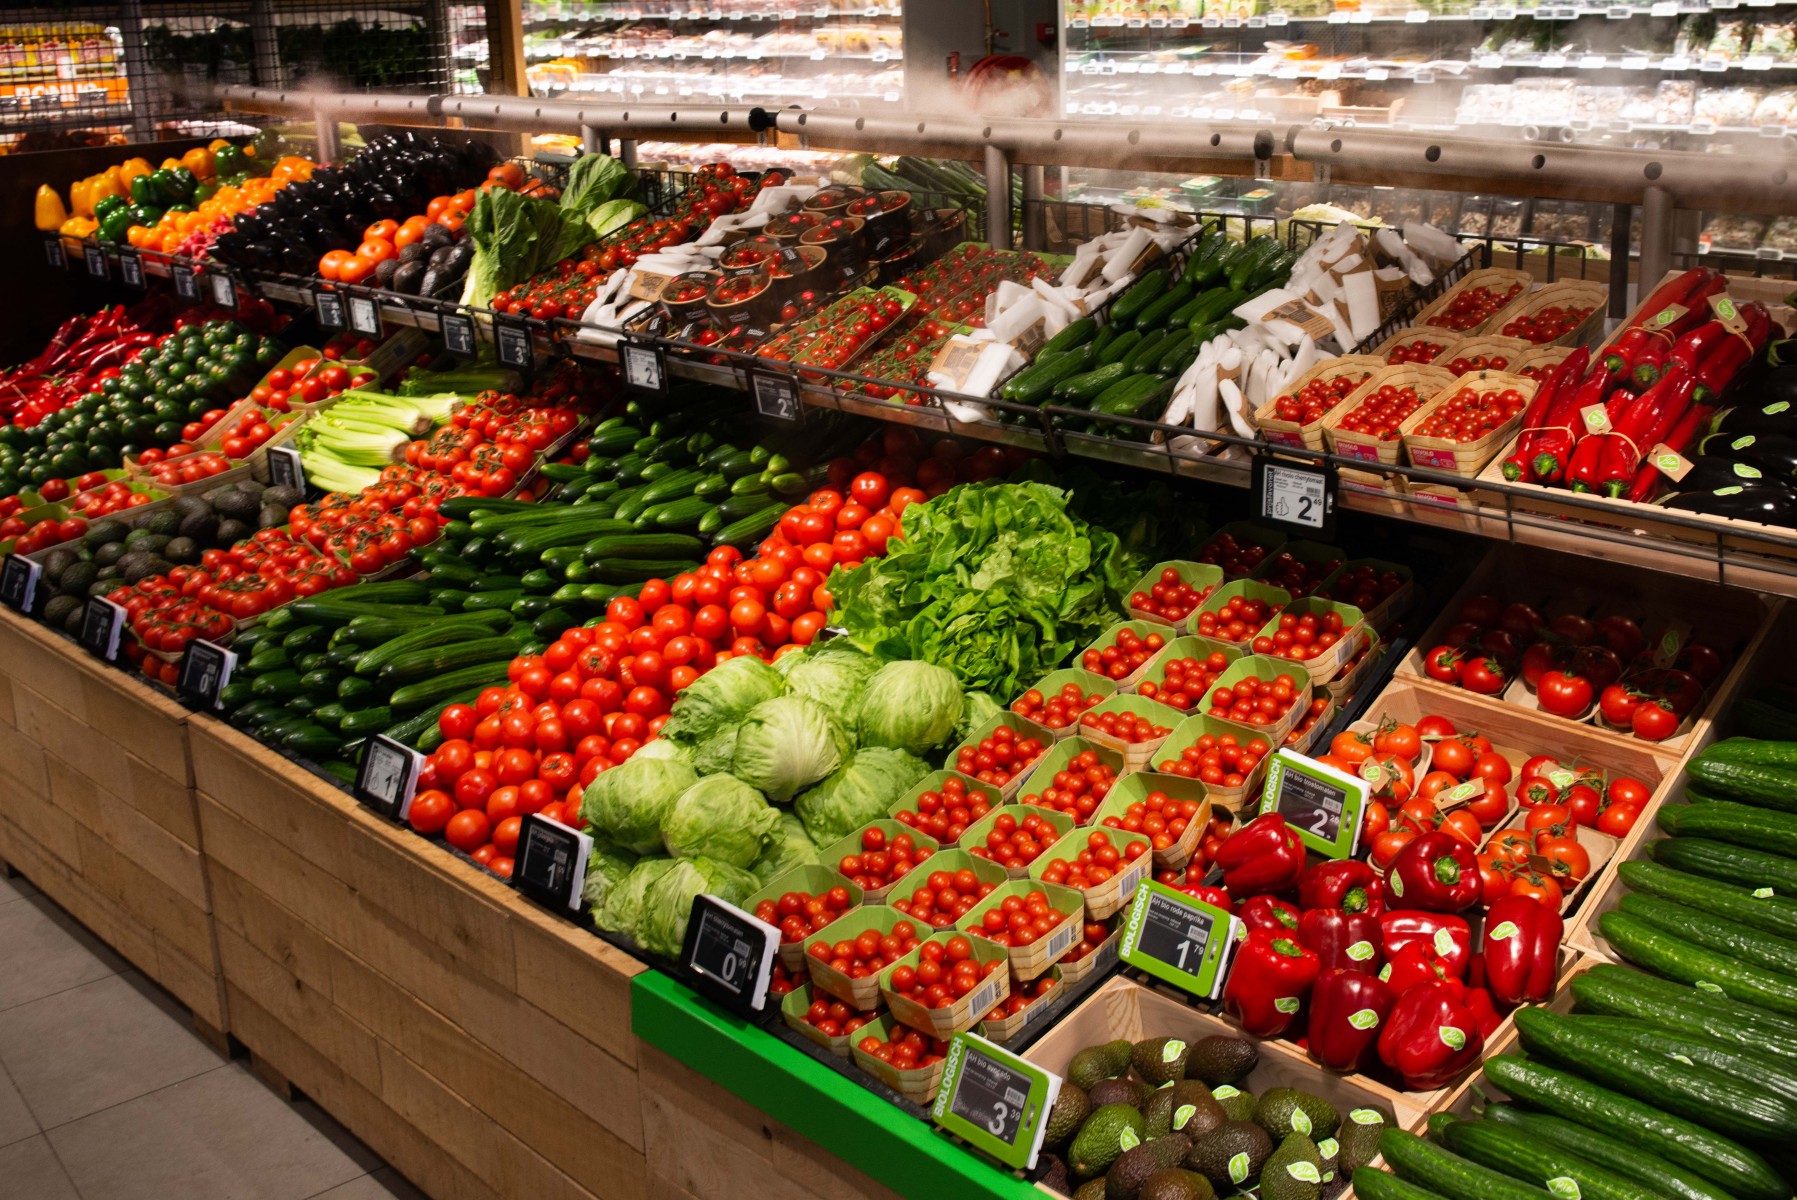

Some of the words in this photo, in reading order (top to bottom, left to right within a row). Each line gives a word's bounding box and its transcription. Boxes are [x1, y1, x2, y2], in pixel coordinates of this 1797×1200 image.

[1313, 498, 1322, 506] 49
[1262, 758, 1281, 814] OLOGISCH
[1285, 770, 1294, 778] AH
[1294, 773, 1303, 783] bio
[1303, 776, 1336, 796] trostomaten
[1121, 883, 1150, 958] BIOLOGISCH
[1151, 897, 1161, 907] AH
[1160, 900, 1170, 911] bio
[1170, 905, 1183, 916] rode
[1183, 911, 1205, 925] paprika
[1193, 944, 1205, 955] 79
[1354, 944, 1370, 957] Bio
[1356, 1012, 1374, 1025] Bio
[1443, 1030, 1462, 1044] Bio
[933, 1036, 963, 1118] BIOLOGISCH
[967, 1053, 977, 1062] AH
[977, 1057, 987, 1068] bio
[986, 1063, 1011, 1081] avocado
[1009, 1109, 1020, 1121] 39
